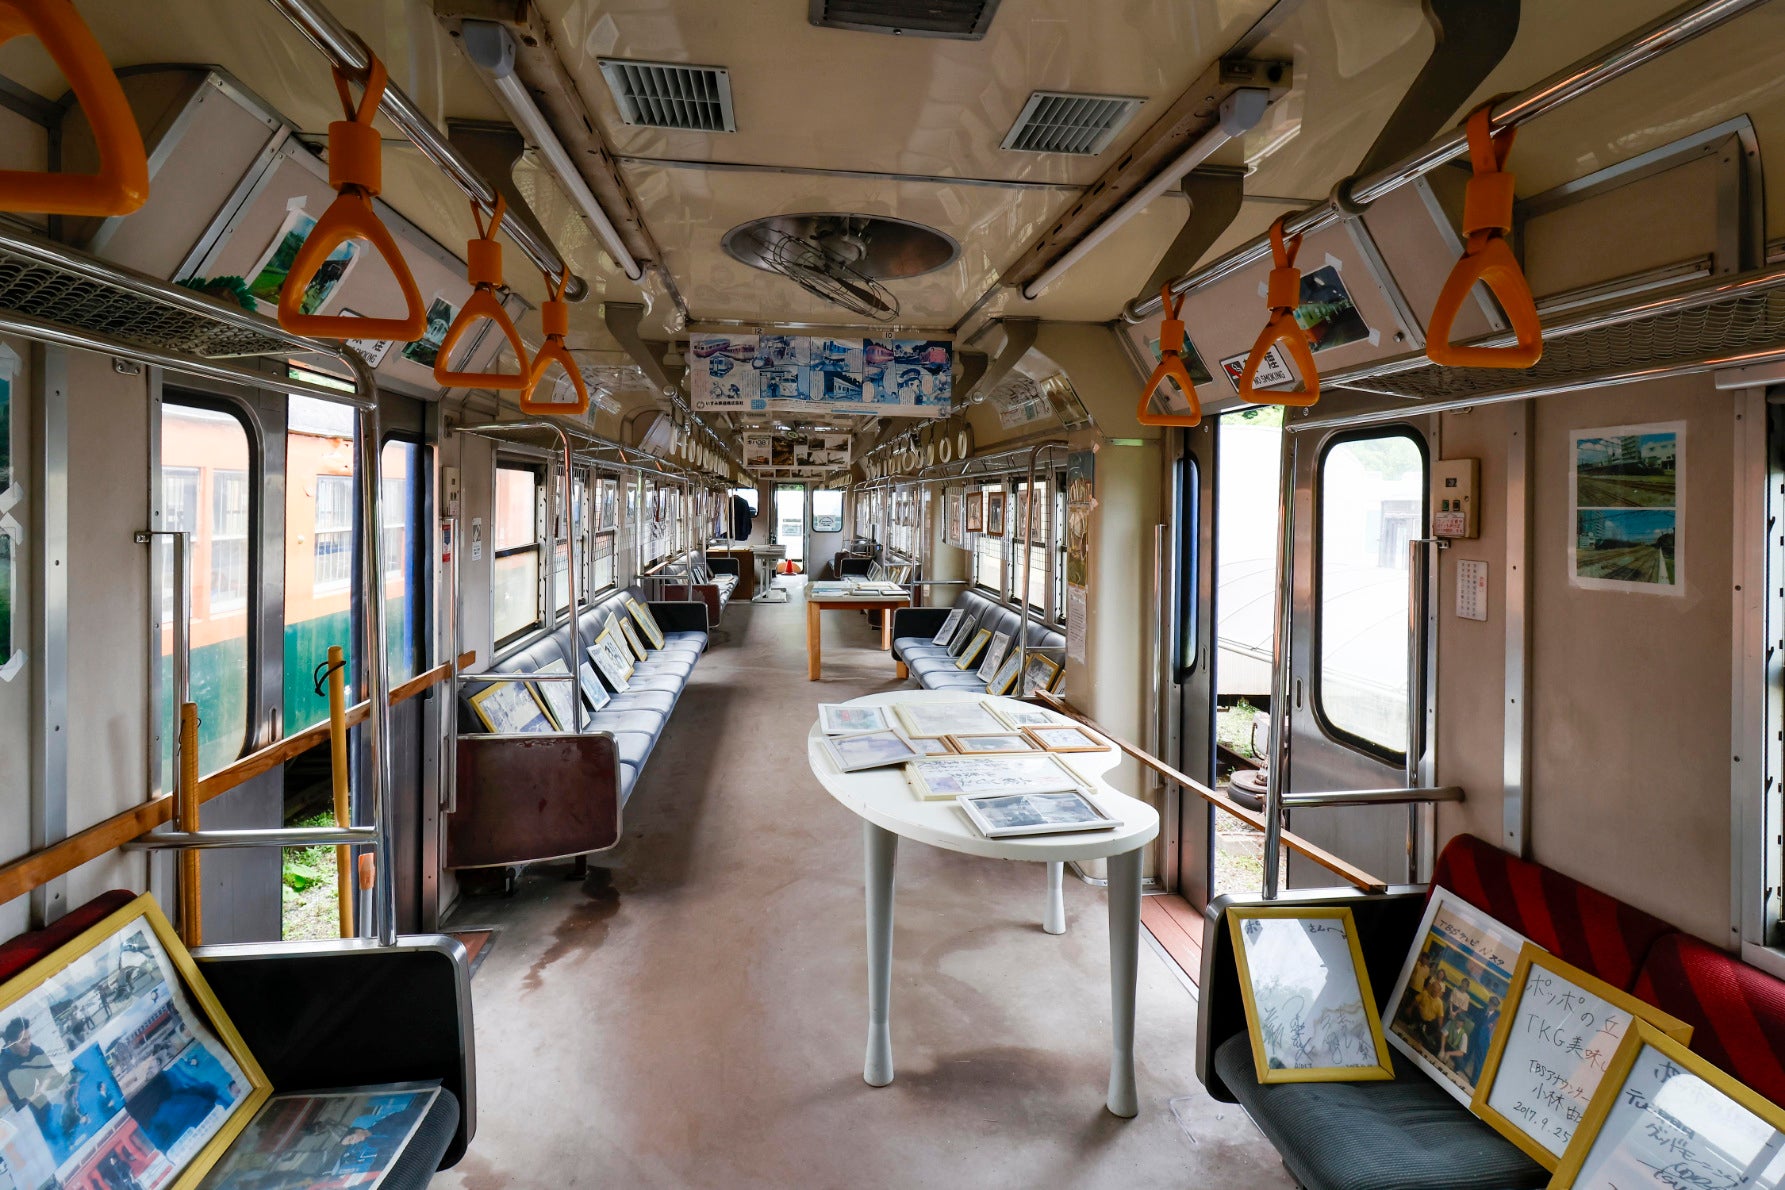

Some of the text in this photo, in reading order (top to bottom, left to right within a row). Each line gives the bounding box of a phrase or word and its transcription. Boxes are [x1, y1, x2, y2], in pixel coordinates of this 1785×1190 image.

[1260, 370, 1285, 384] SMOKING
[1525, 973, 1620, 1040] ポッポの丘
[1529, 1060, 1592, 1102] TBSアナウンサー
